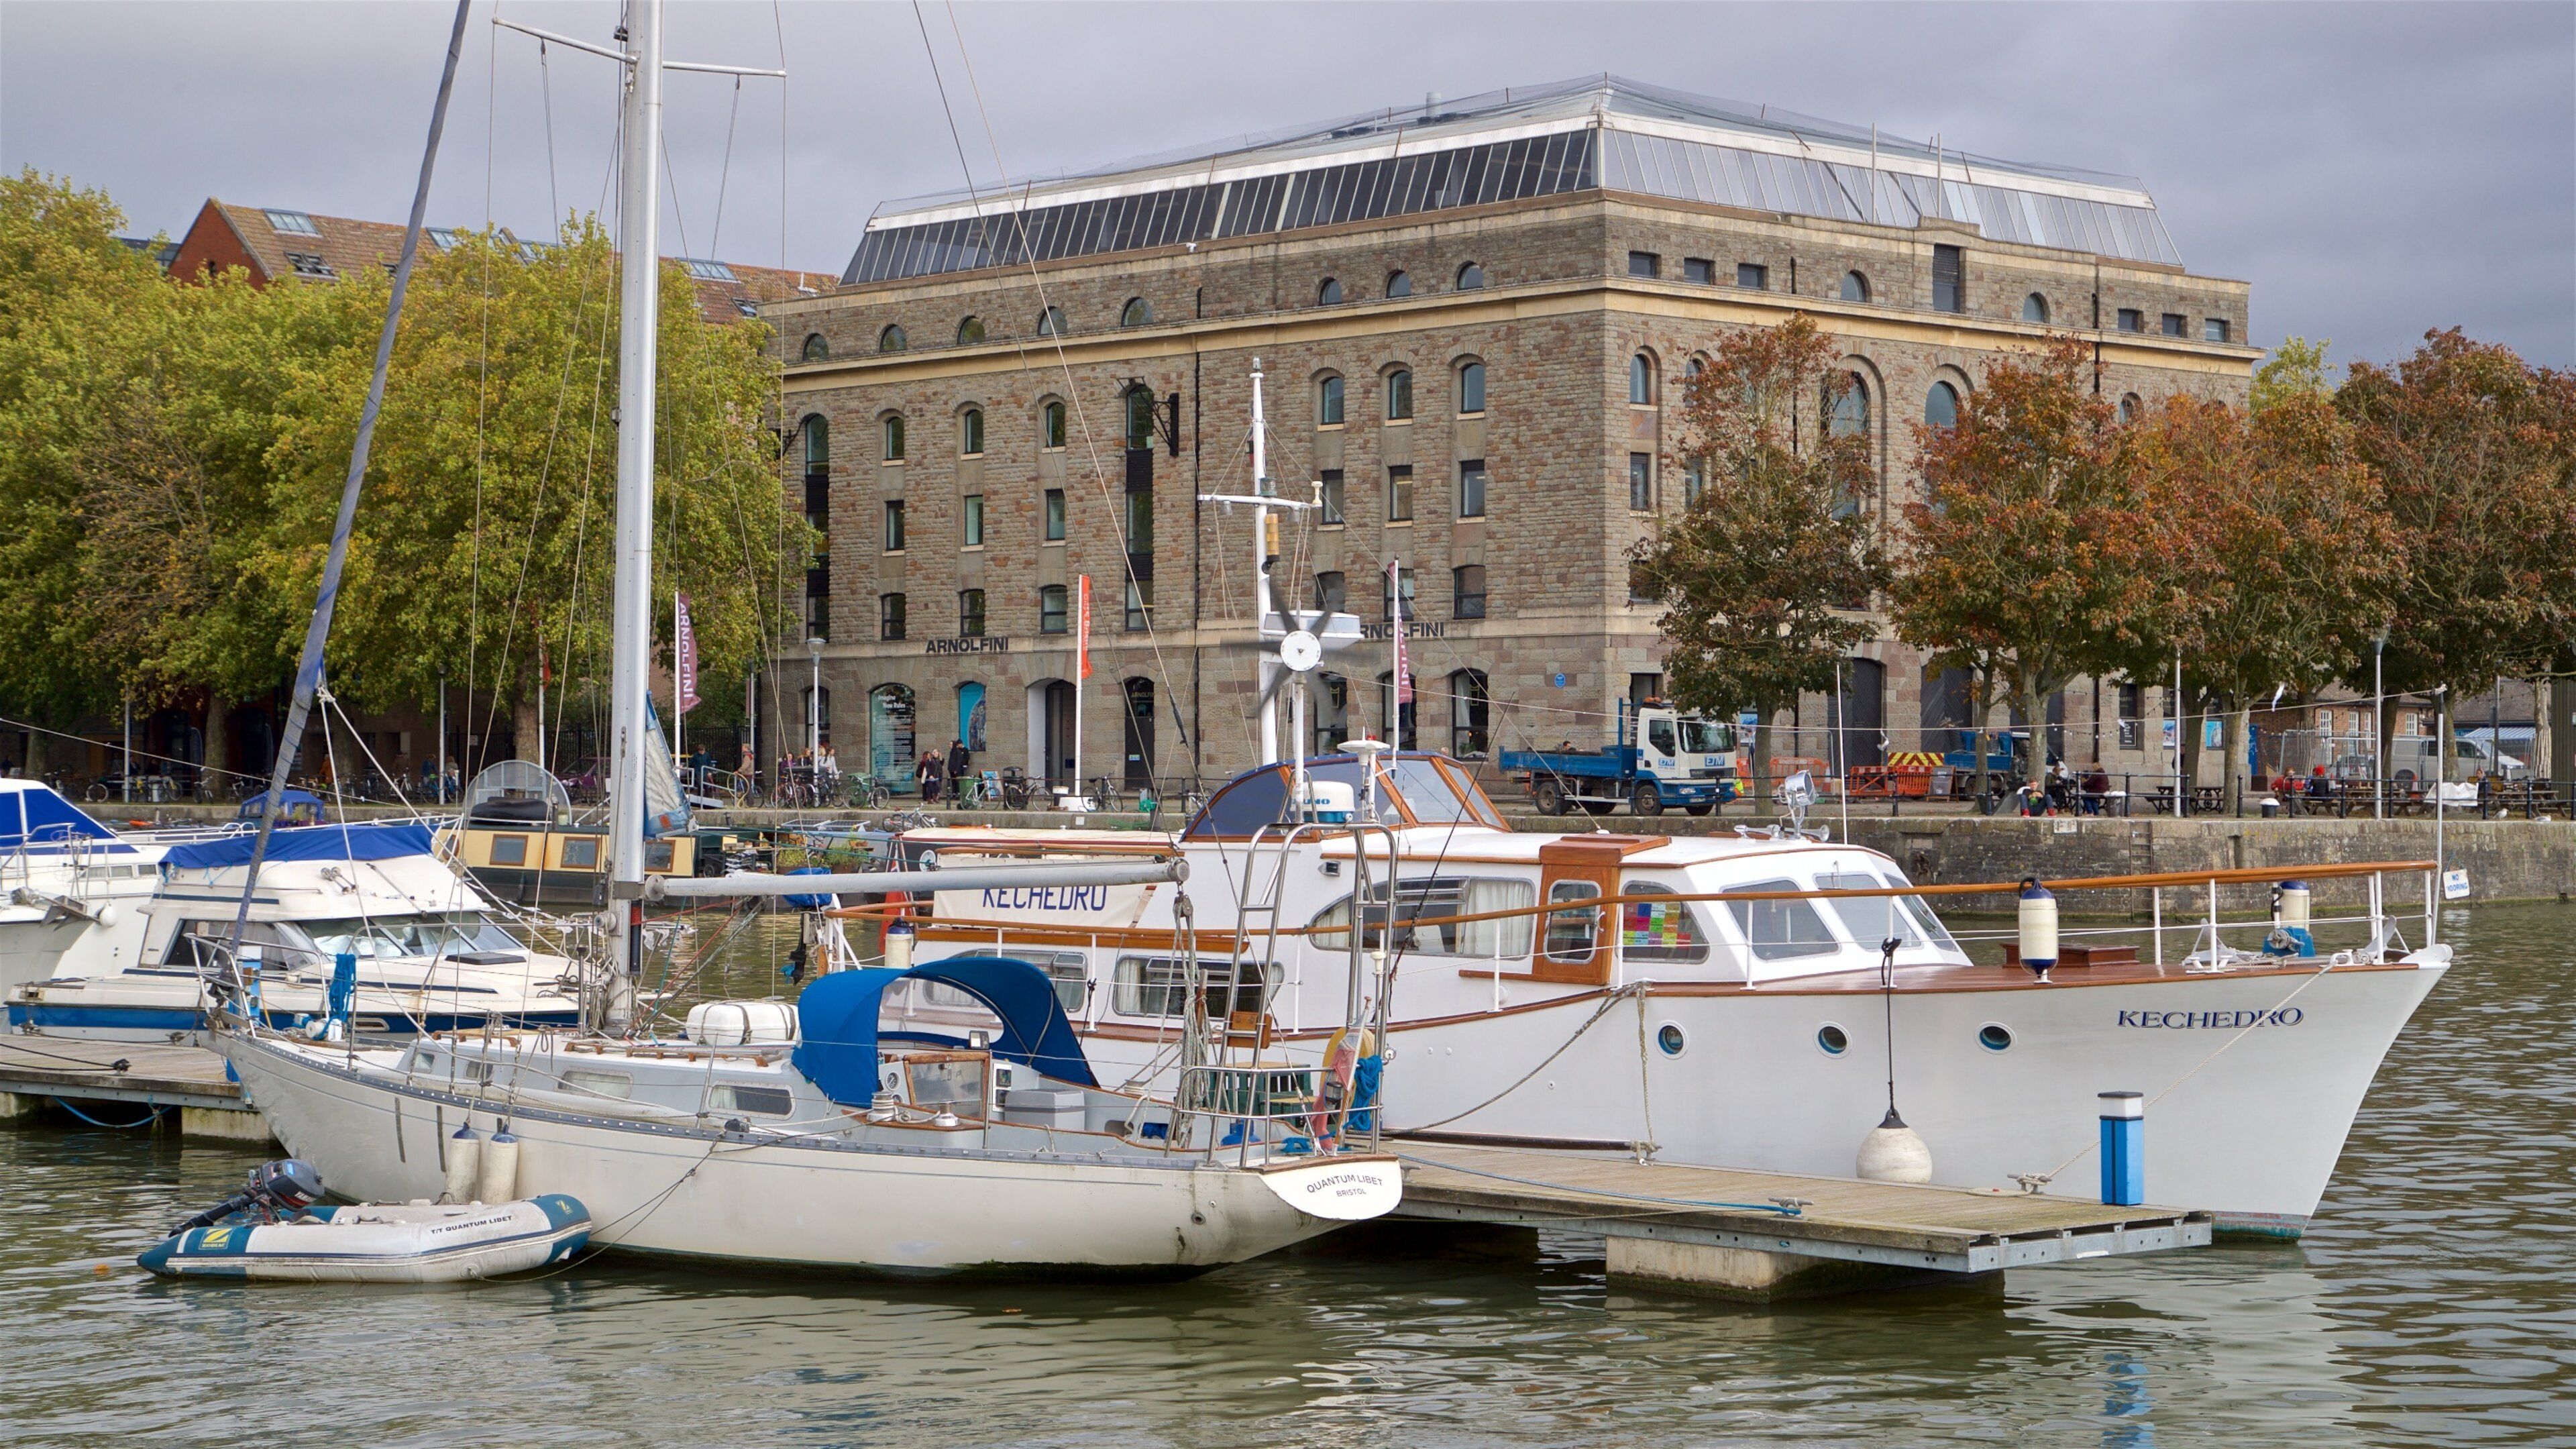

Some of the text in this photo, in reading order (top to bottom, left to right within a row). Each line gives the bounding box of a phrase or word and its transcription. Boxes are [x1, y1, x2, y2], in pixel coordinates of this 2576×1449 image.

[680, 602, 694, 698] ARNOLFINI
[926, 637, 1009, 653] ARNOLFINI
[982, 885, 1107, 911] KECHEDRO
[2118, 1008, 2304, 1029] KECHEDRO
[1307, 1175, 1383, 1193] QUANTUM LIBET
[1336, 1189, 1366, 1197] BRISTOL
[445, 1220, 487, 1232] QUANTUM
[488, 1216, 513, 1224] LIBET
